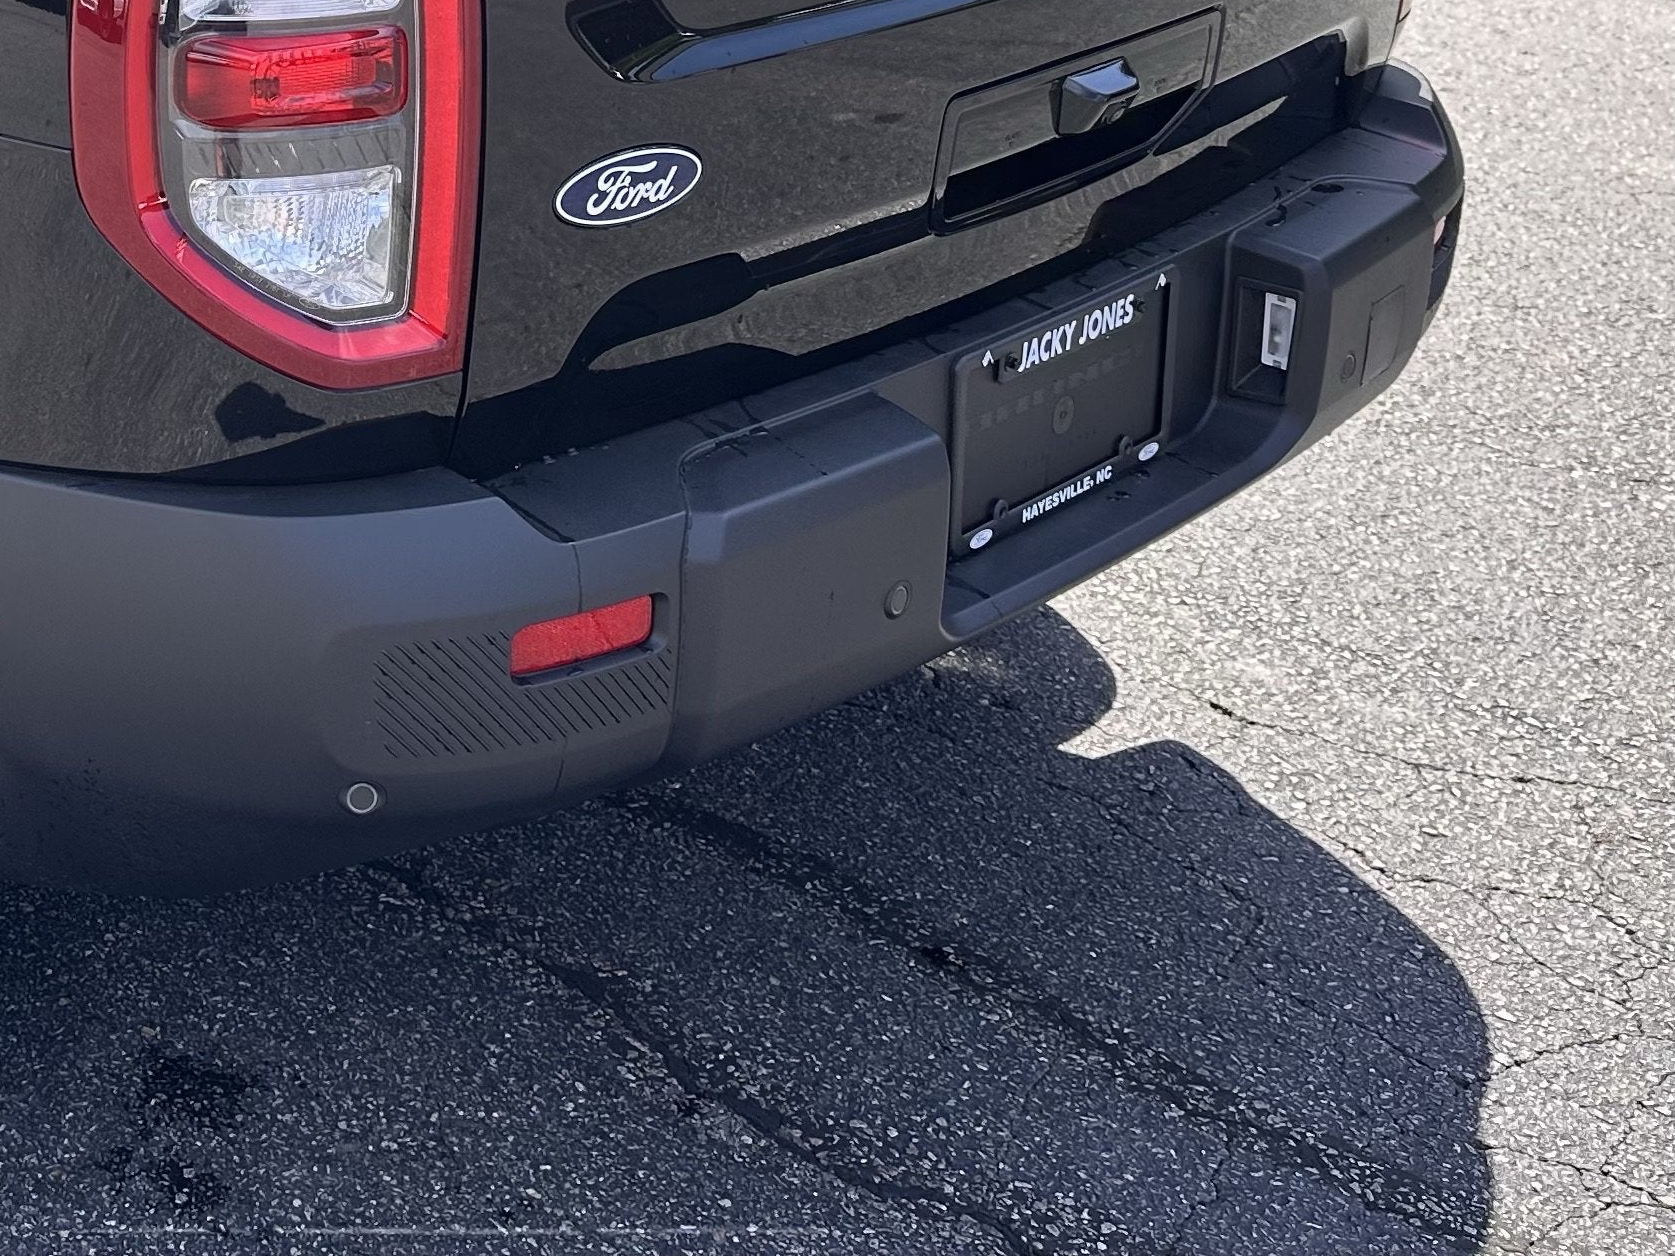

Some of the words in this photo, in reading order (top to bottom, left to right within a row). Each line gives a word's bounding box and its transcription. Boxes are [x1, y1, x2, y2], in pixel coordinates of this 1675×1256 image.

[586, 160, 678, 216] Ford
[1017, 320, 1077, 373] JACKY
[1078, 293, 1135, 345] JONES
[1022, 475, 1094, 524] HAYESVILLE,
[1095, 465, 1113, 485] NC
